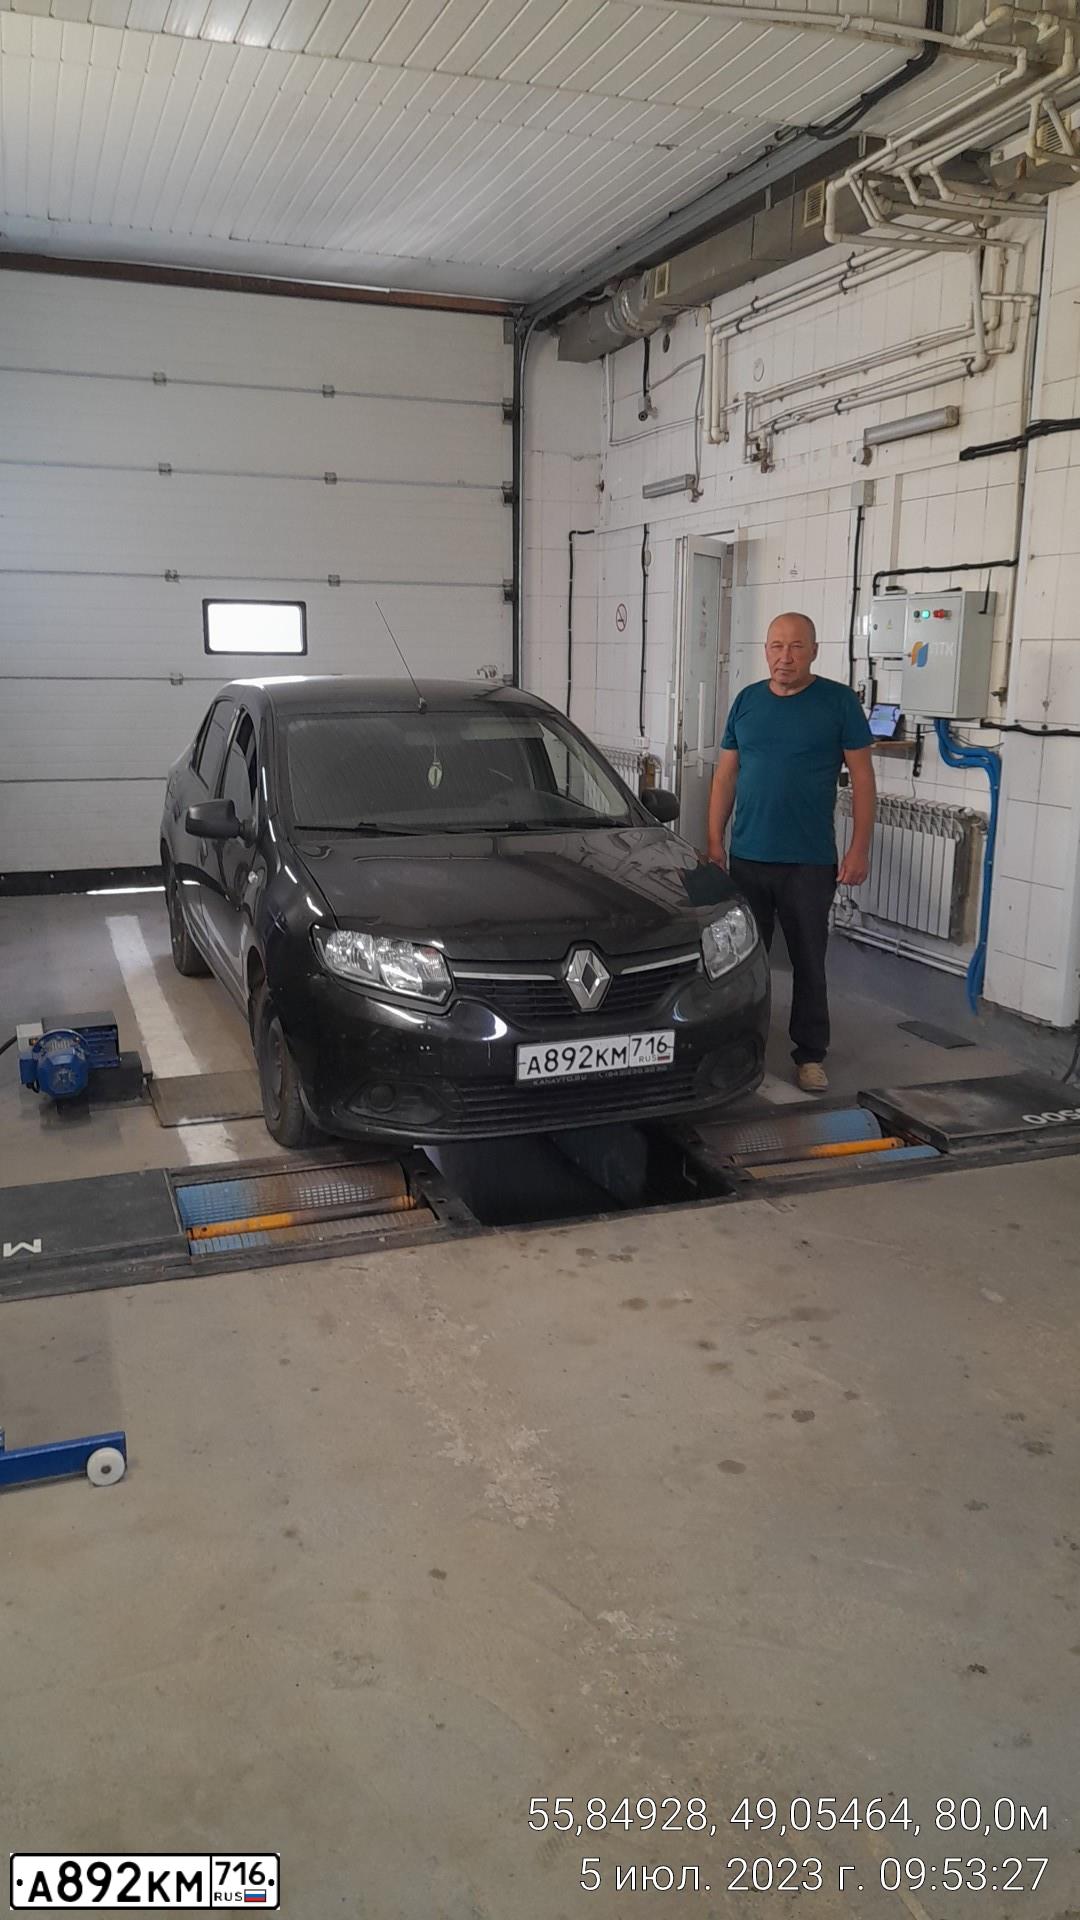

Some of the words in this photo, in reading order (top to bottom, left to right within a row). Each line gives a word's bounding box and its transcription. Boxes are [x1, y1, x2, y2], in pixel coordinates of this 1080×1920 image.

[526, 1045, 627, 1075] А892КМ
[631, 1035, 668, 1056] 716
[638, 1054, 657, 1063] RUS
